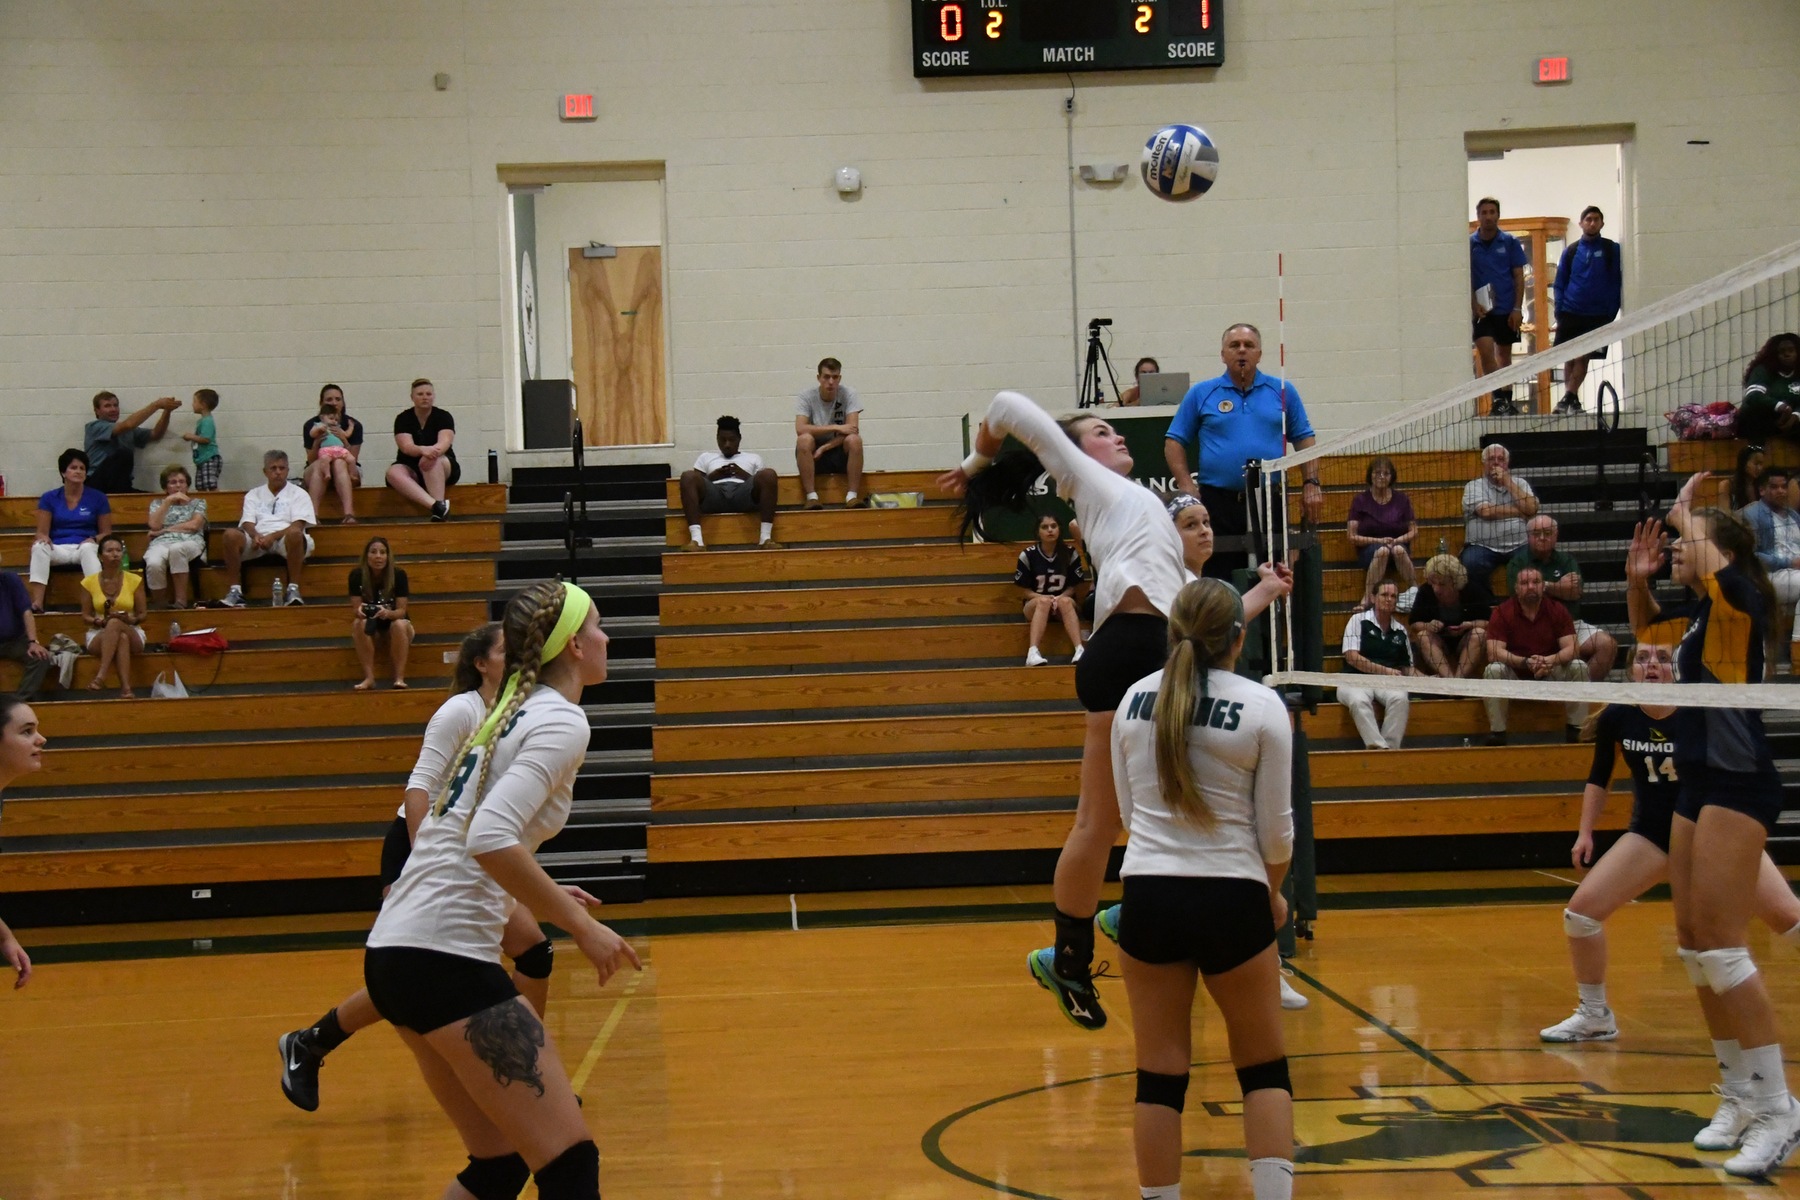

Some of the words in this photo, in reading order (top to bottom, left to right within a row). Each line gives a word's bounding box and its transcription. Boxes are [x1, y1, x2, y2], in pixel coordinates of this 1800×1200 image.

[941, 5, 962, 41] 0
[986, 11, 1002, 38] 2
[1135, 5, 1152, 33] 2
[922, 51, 970, 67] SCORE
[1043, 47, 1095, 63] MATCH
[1168, 42, 1216, 58] SCORE
[1150, 136, 1168, 181] molten
[1035, 574, 1067, 593] 12
[1126, 691, 1245, 732] MUNGS
[1622, 738, 1674, 753] SIMMO
[1644, 755, 1678, 783] 14
